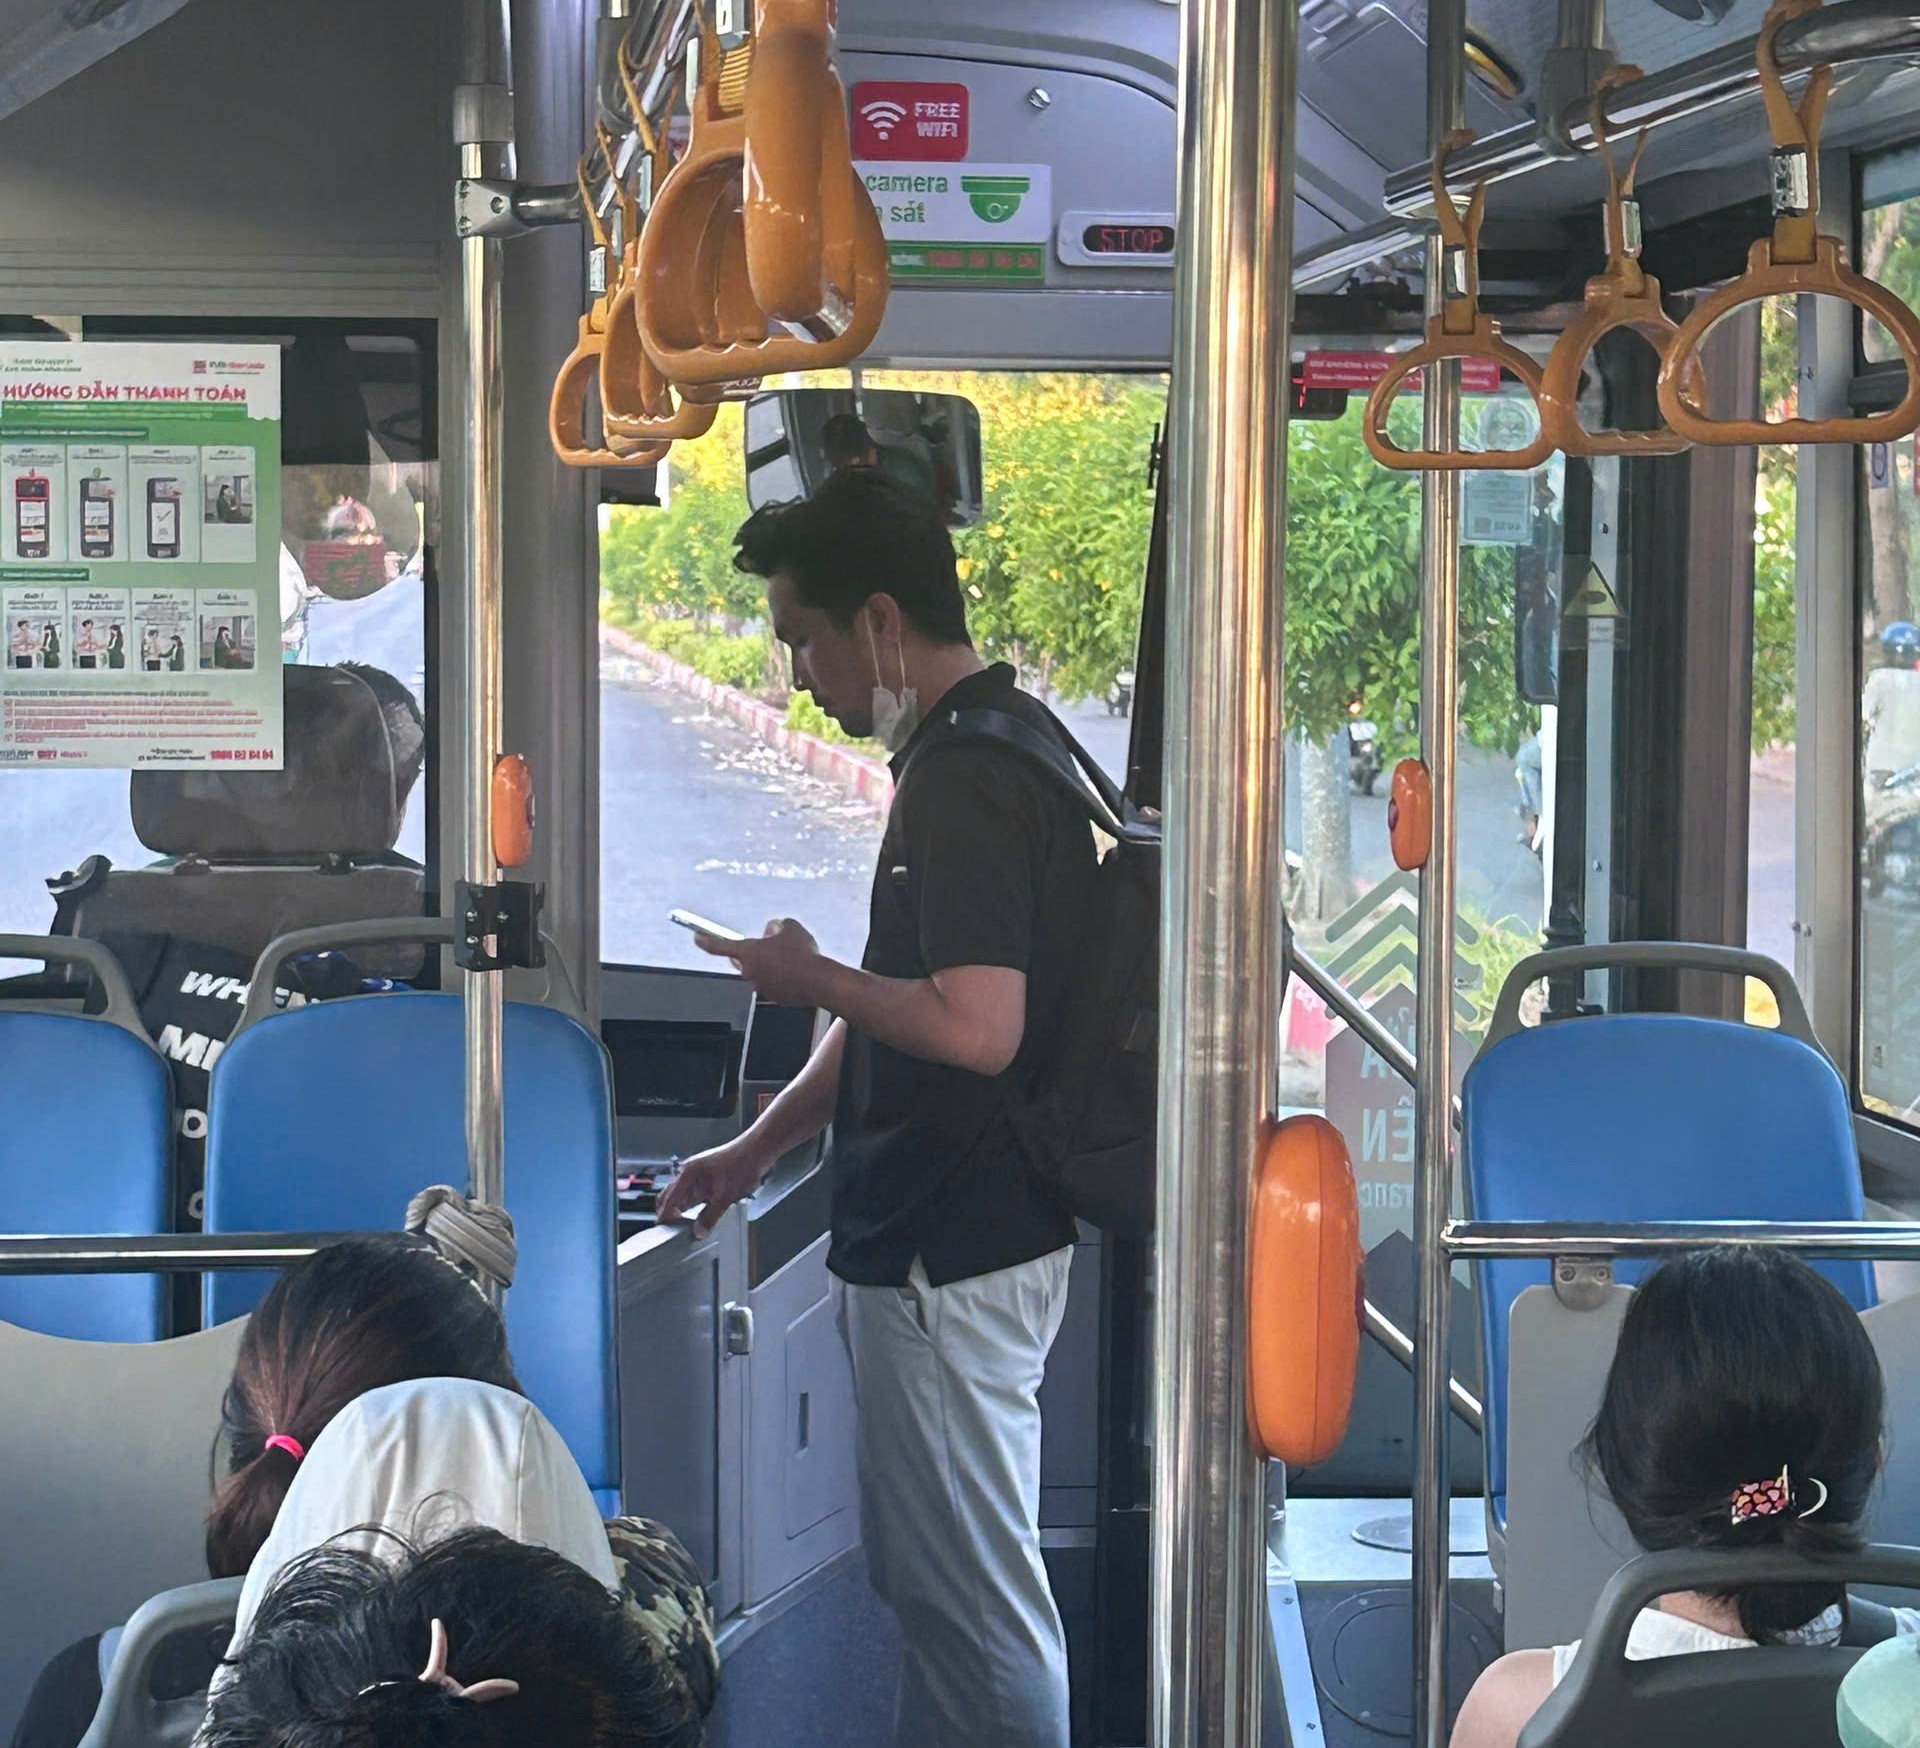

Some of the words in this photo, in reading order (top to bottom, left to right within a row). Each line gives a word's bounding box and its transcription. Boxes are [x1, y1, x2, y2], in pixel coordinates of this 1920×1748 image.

[914, 102, 960, 118] FREE
[916, 121, 959, 137] WIFI
[865, 175, 948, 193] camera
[1100, 228, 1164, 252] STOP
[4, 382, 73, 400] HƯỚNG
[123, 385, 190, 400] THANH
[194, 384, 247, 401] TOÁN
